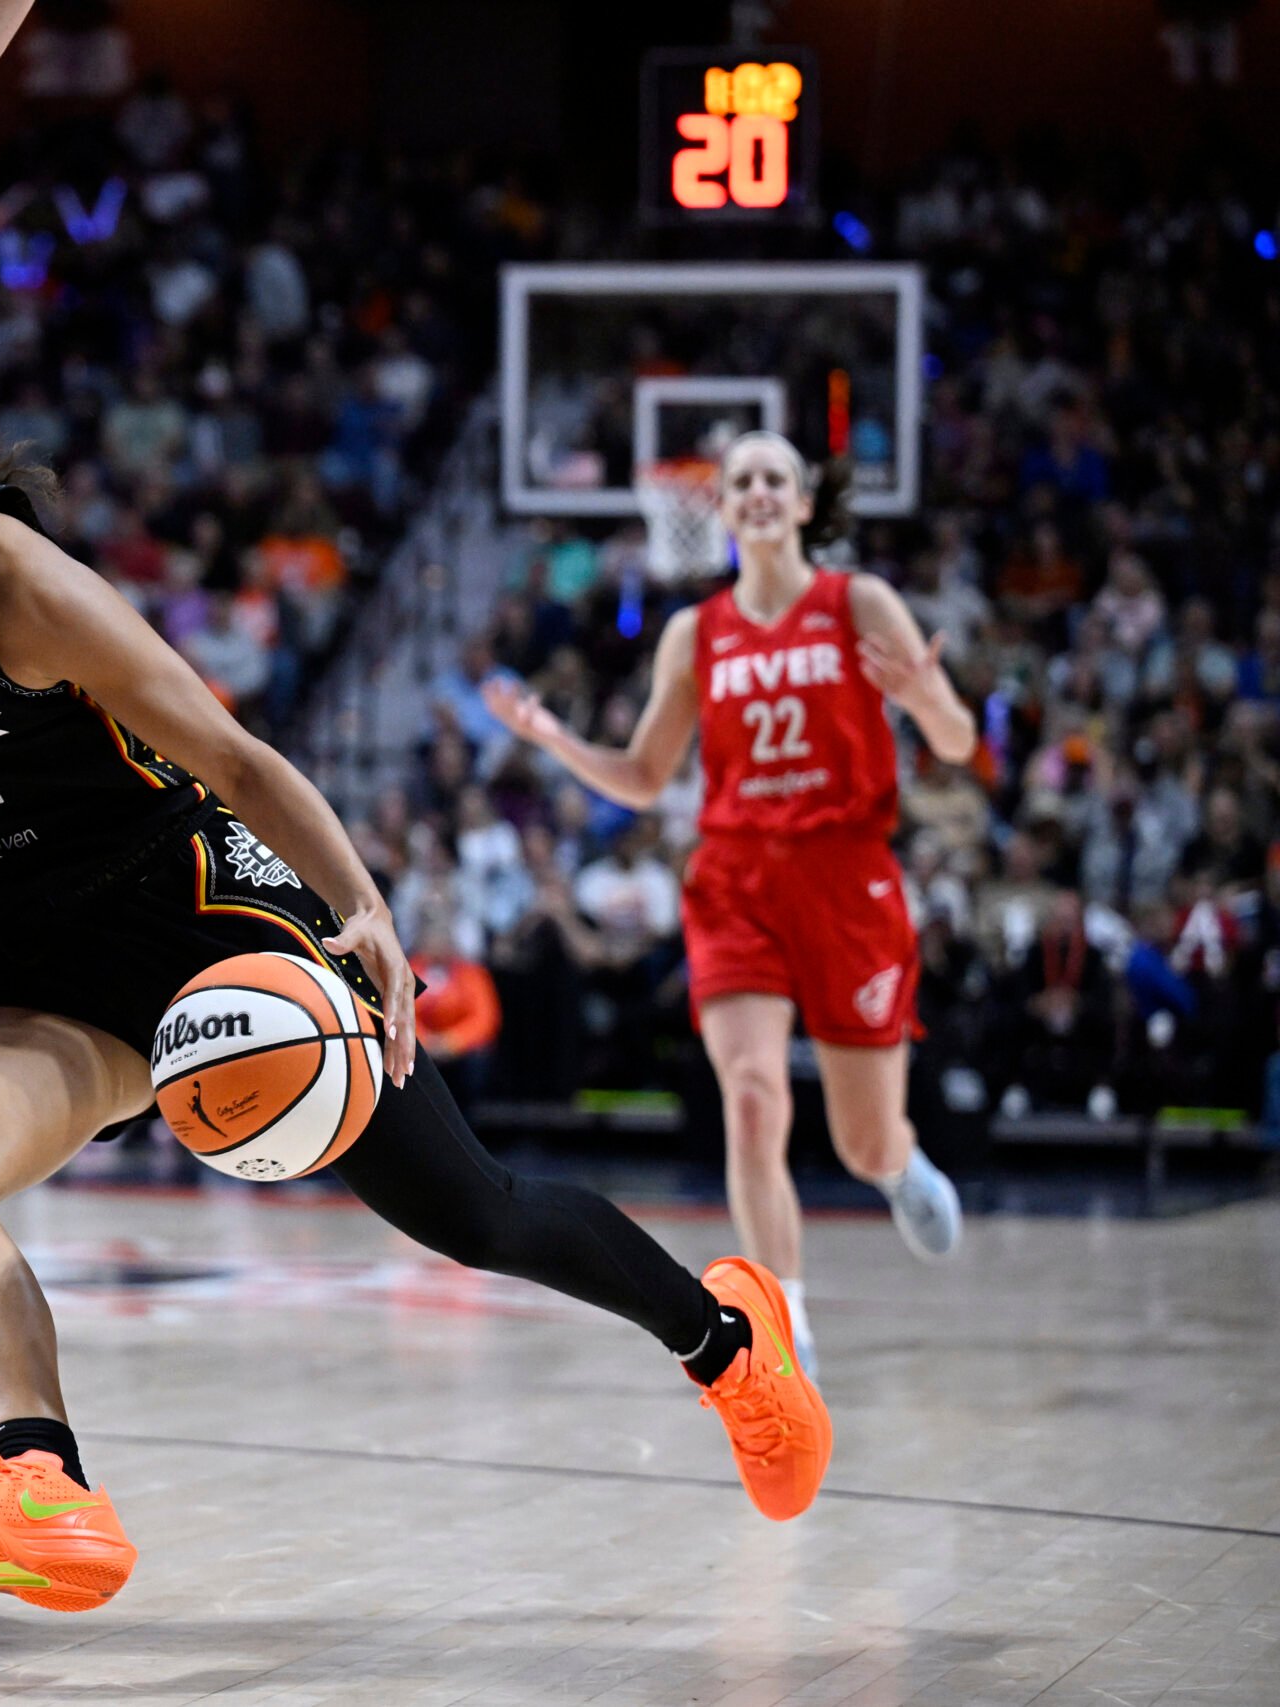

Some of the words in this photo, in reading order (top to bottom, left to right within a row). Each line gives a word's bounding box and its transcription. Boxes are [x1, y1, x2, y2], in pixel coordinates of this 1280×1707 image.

[672, 114, 788, 208] 20
[711, 643, 842, 702] FEVER
[743, 694, 812, 764] 22
[152, 1012, 252, 1071] Wilson
